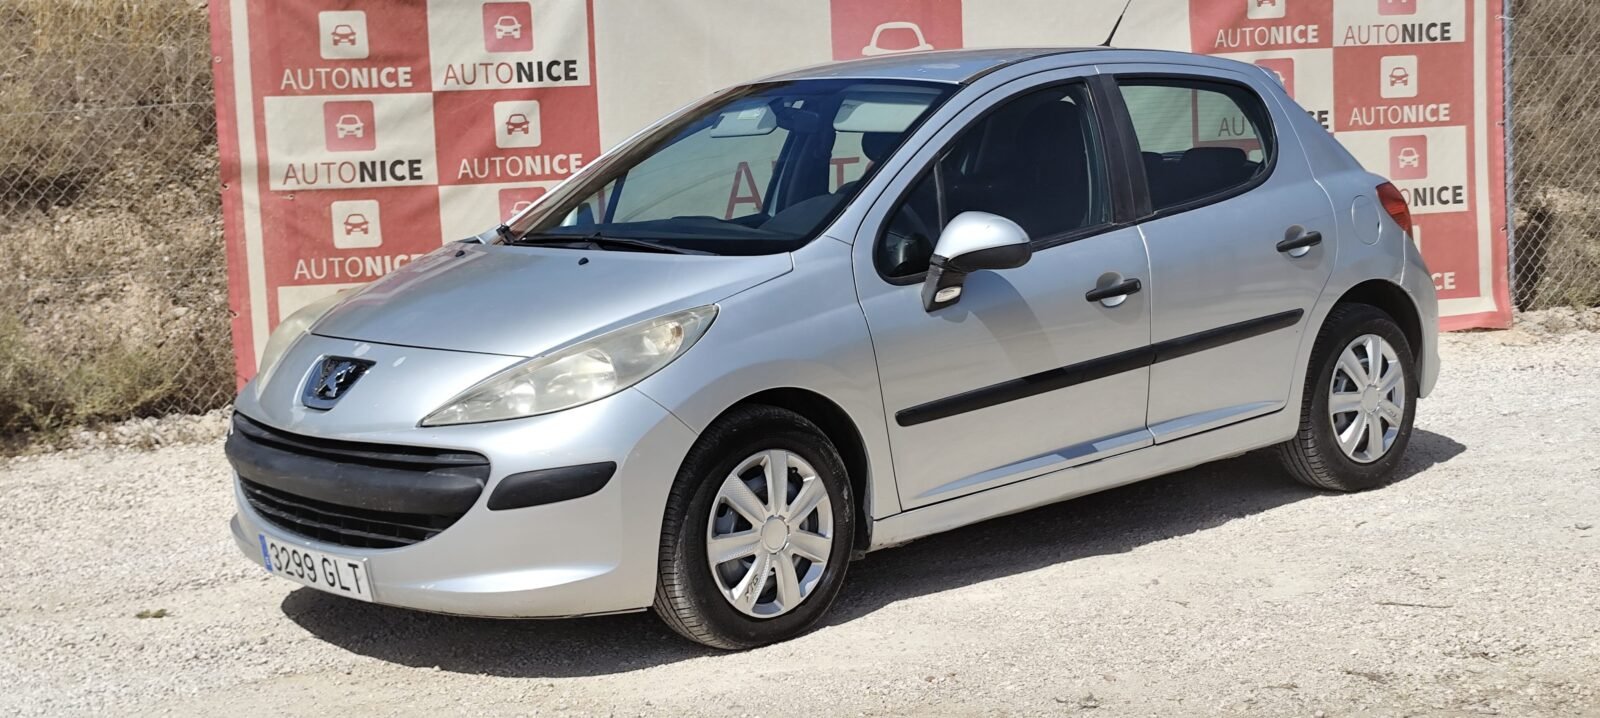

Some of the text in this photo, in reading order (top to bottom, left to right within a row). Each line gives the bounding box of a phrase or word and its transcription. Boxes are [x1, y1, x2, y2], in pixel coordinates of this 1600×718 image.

[1215, 25, 1319, 47] AUTONICE
[1343, 22, 1452, 45] AUTONICE
[280, 66, 414, 91] AUTONICE
[443, 59, 578, 86] AUTONICE
[1349, 103, 1451, 126] AUTONICE
[282, 159, 424, 185] AUTONICE
[457, 153, 584, 180] AUTONICE
[294, 253, 424, 280] AUTONIC
[270, 542, 362, 594] 3299 GLT
